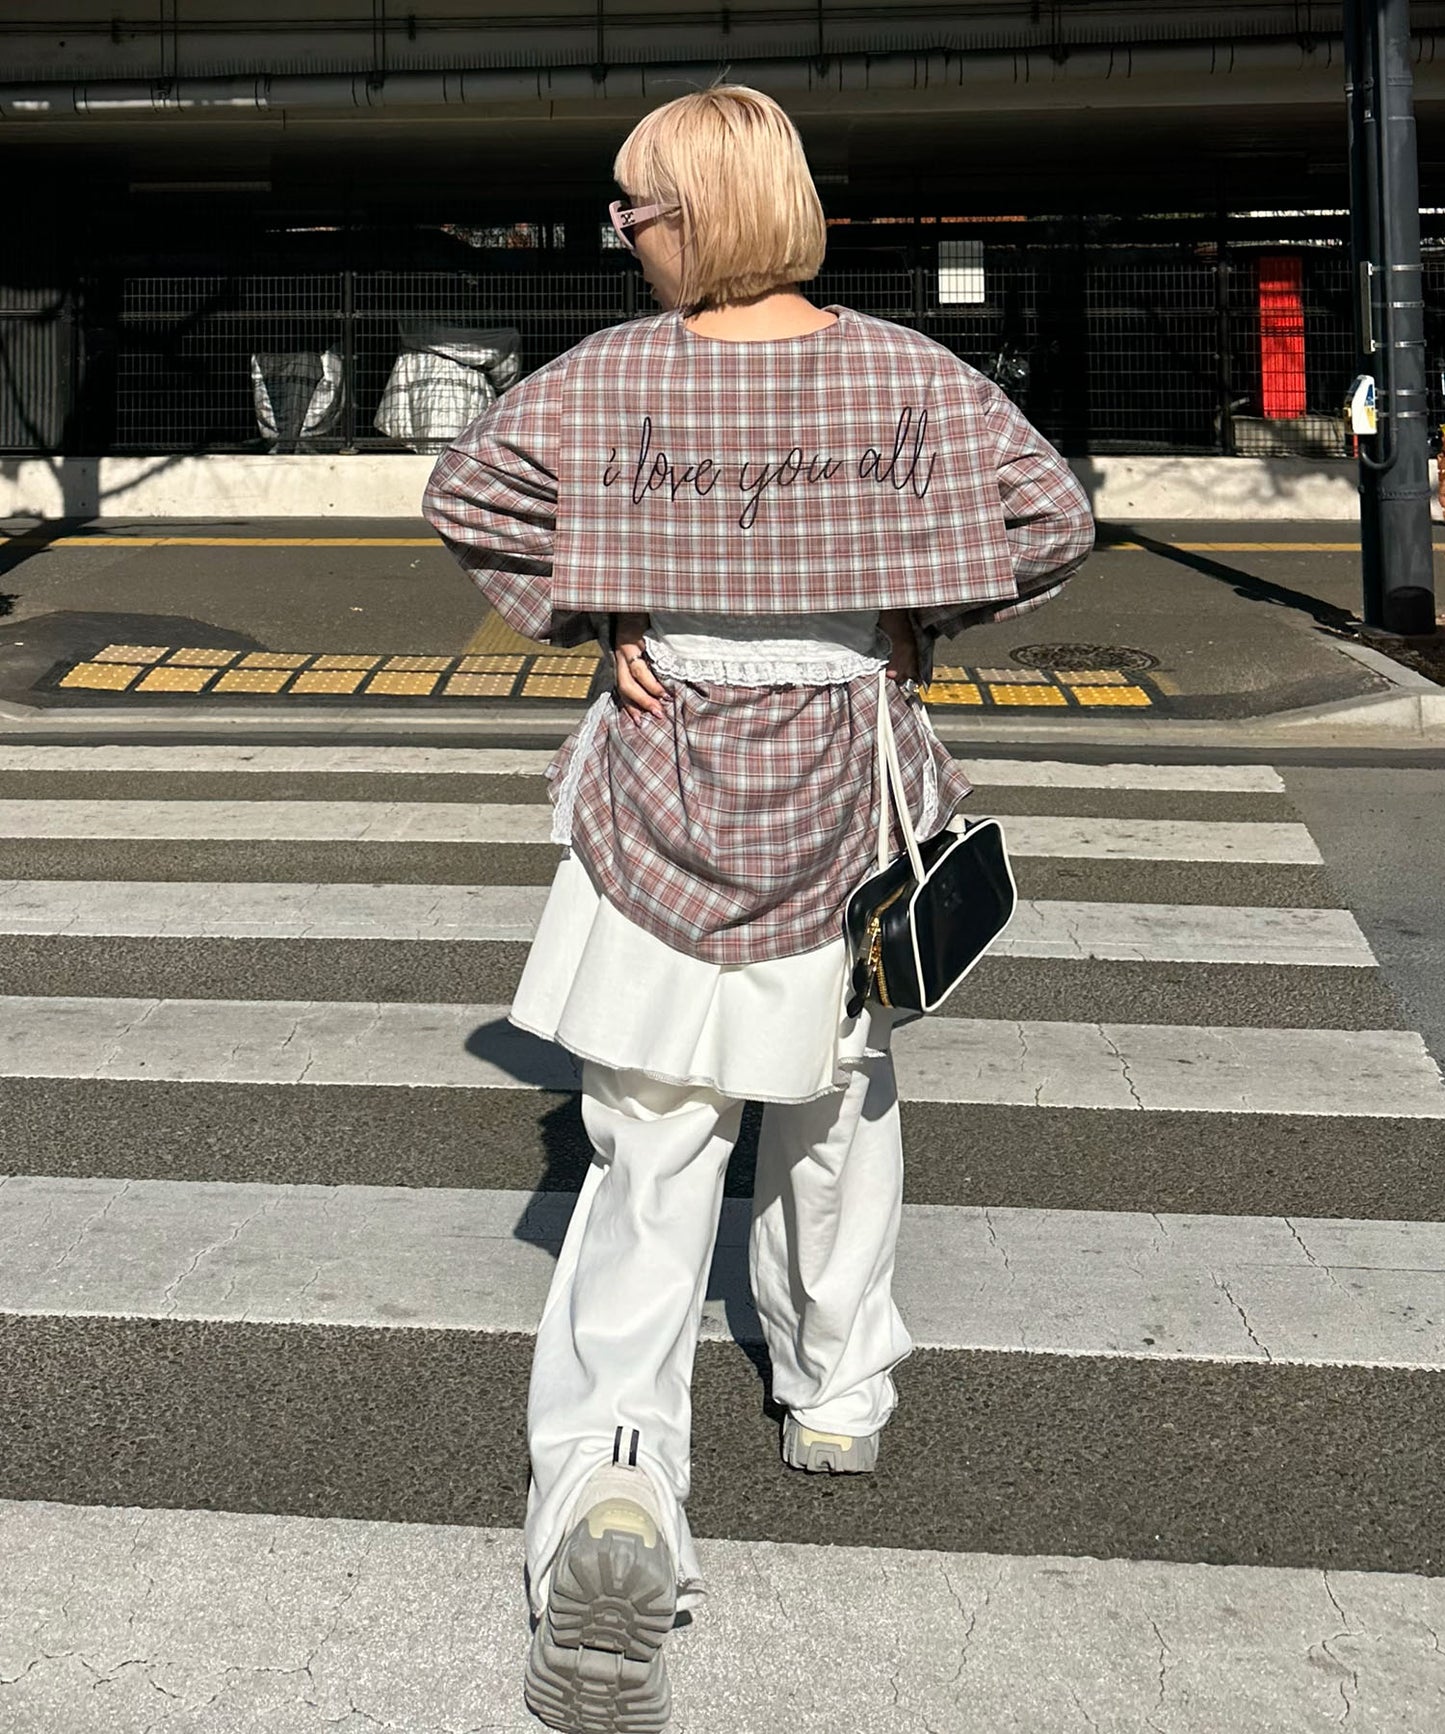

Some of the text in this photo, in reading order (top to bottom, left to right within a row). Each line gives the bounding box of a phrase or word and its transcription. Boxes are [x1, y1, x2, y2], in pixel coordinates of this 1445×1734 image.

[603, 406, 938, 530] i love you all
